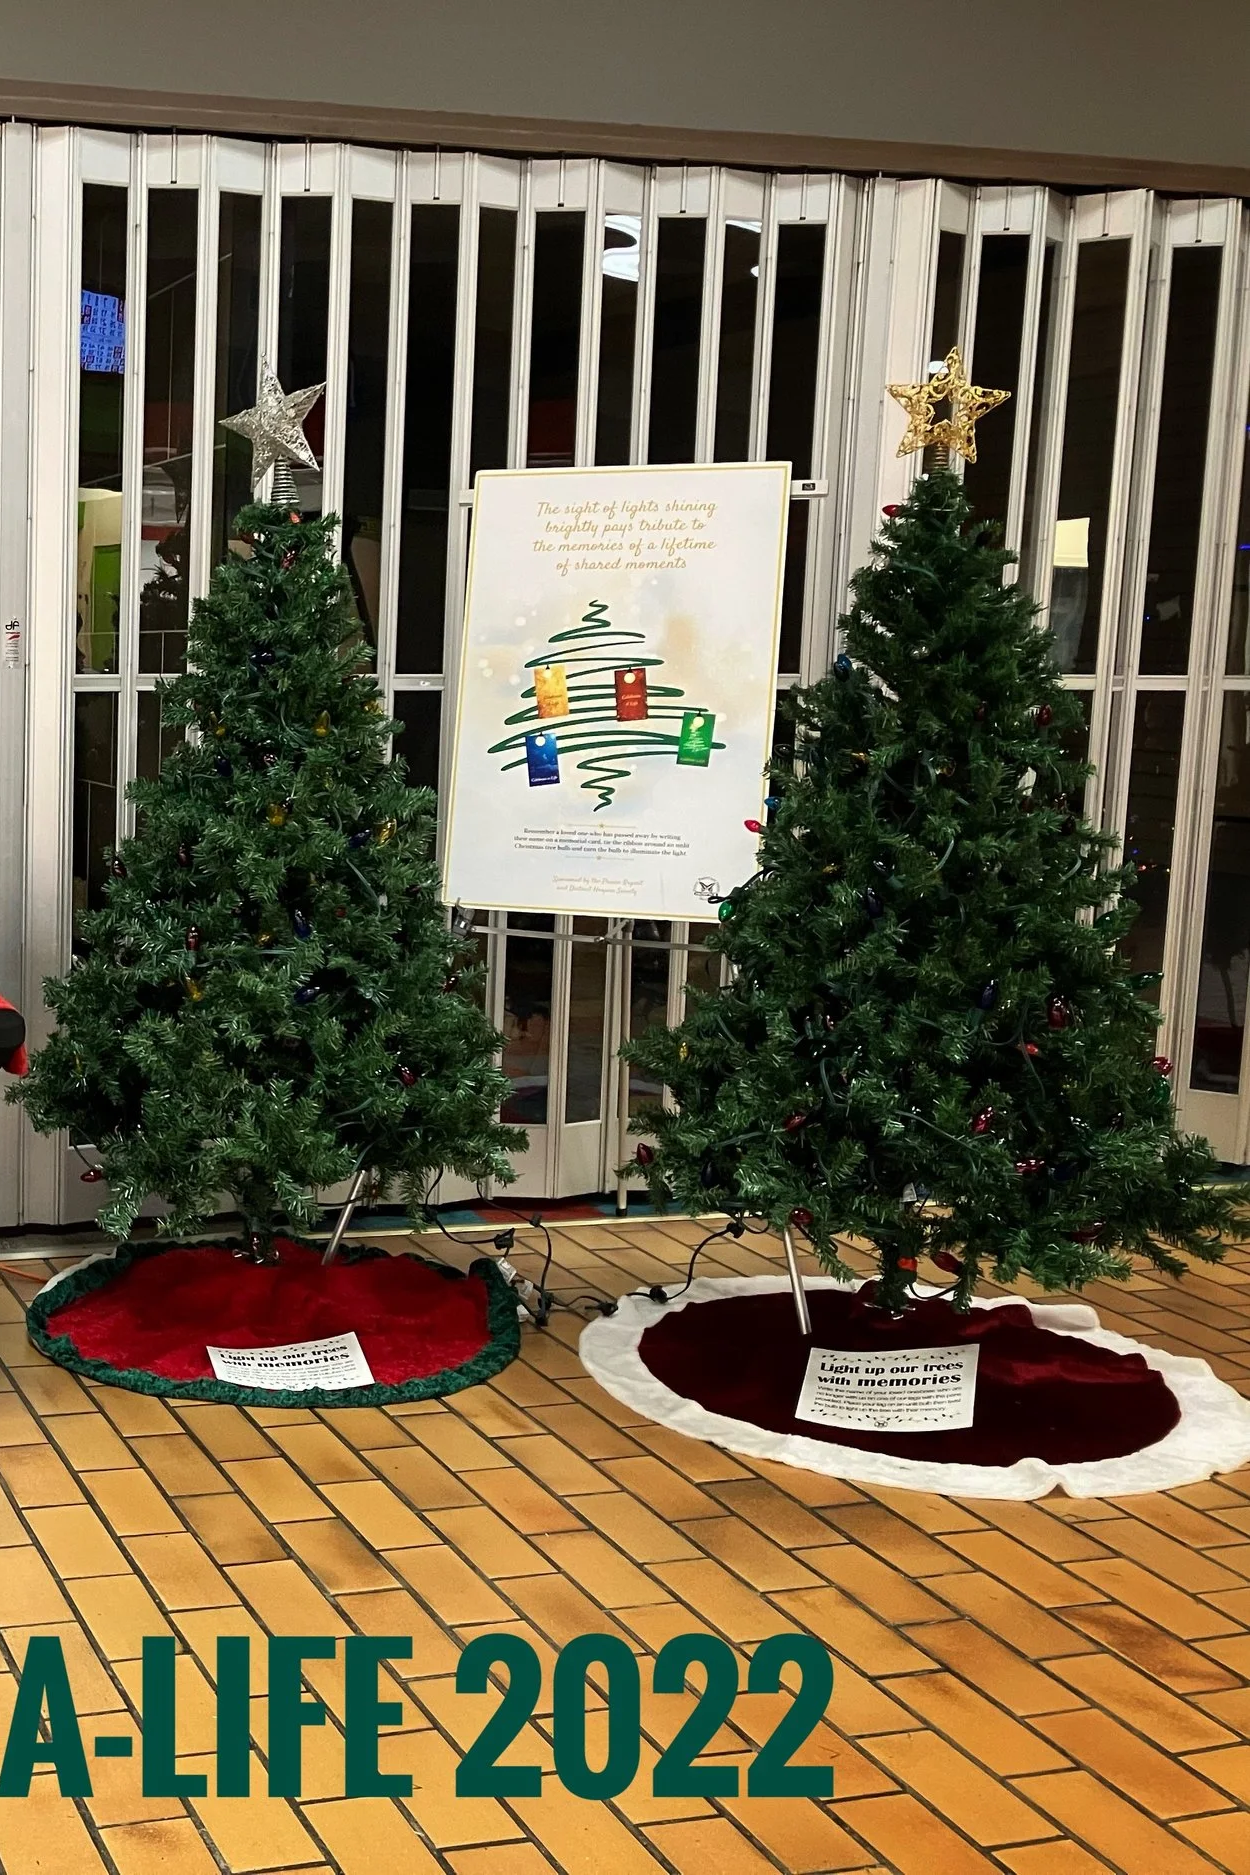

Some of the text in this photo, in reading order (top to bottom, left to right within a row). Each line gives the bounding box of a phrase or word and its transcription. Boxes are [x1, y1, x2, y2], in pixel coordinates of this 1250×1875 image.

[538, 500, 716, 520] The sight of lights shining
[546, 518, 706, 539] brightly pays tribute to
[533, 538, 716, 556] the memories of a lifetime
[556, 557, 687, 576] of shared moments
[312, 1346, 347, 1355] trees
[257, 1354, 350, 1367] memories
[820, 1362, 964, 1376] Light up our trees
[818, 1374, 962, 1387] with memories
